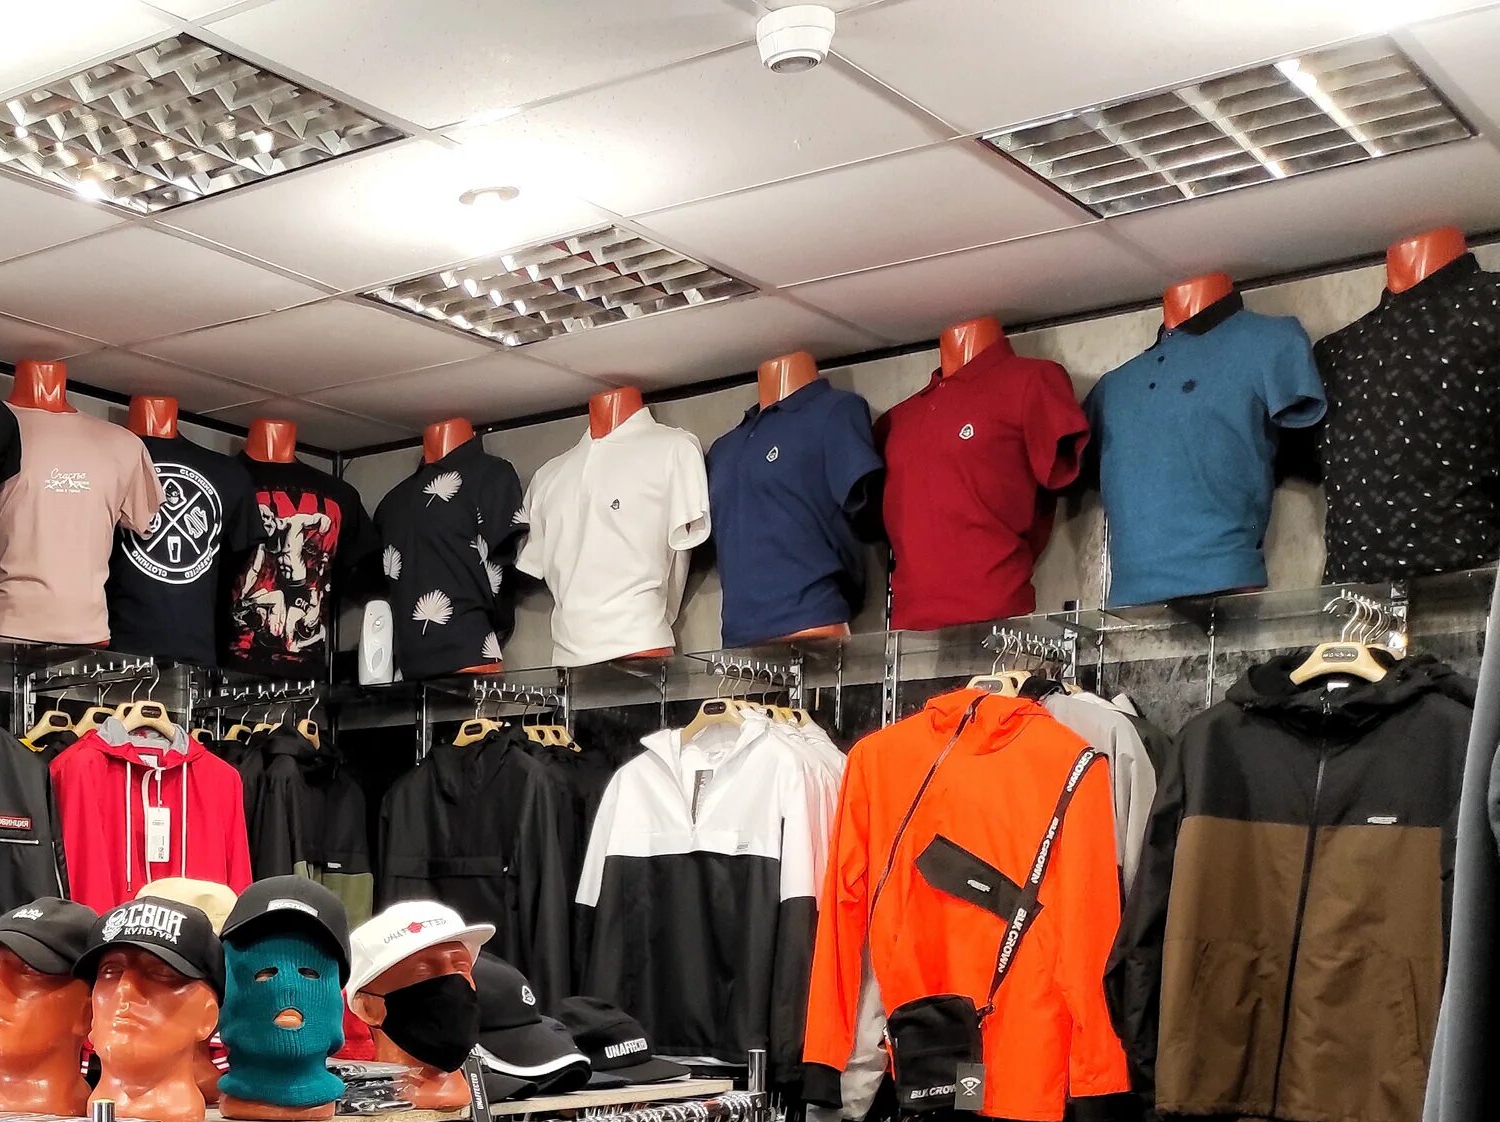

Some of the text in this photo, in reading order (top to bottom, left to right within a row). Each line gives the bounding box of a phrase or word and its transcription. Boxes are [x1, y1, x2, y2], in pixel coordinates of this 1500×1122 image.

[1067, 751, 1093, 792] CROWN
[1031, 838, 1051, 884] CROWN
[124, 926, 178, 944] КУЛЬТУРА
[128, 903, 188, 937] СВОЯ
[384, 918, 447, 944] UNAFCTED
[998, 907, 1027, 974] BLK CROWN
